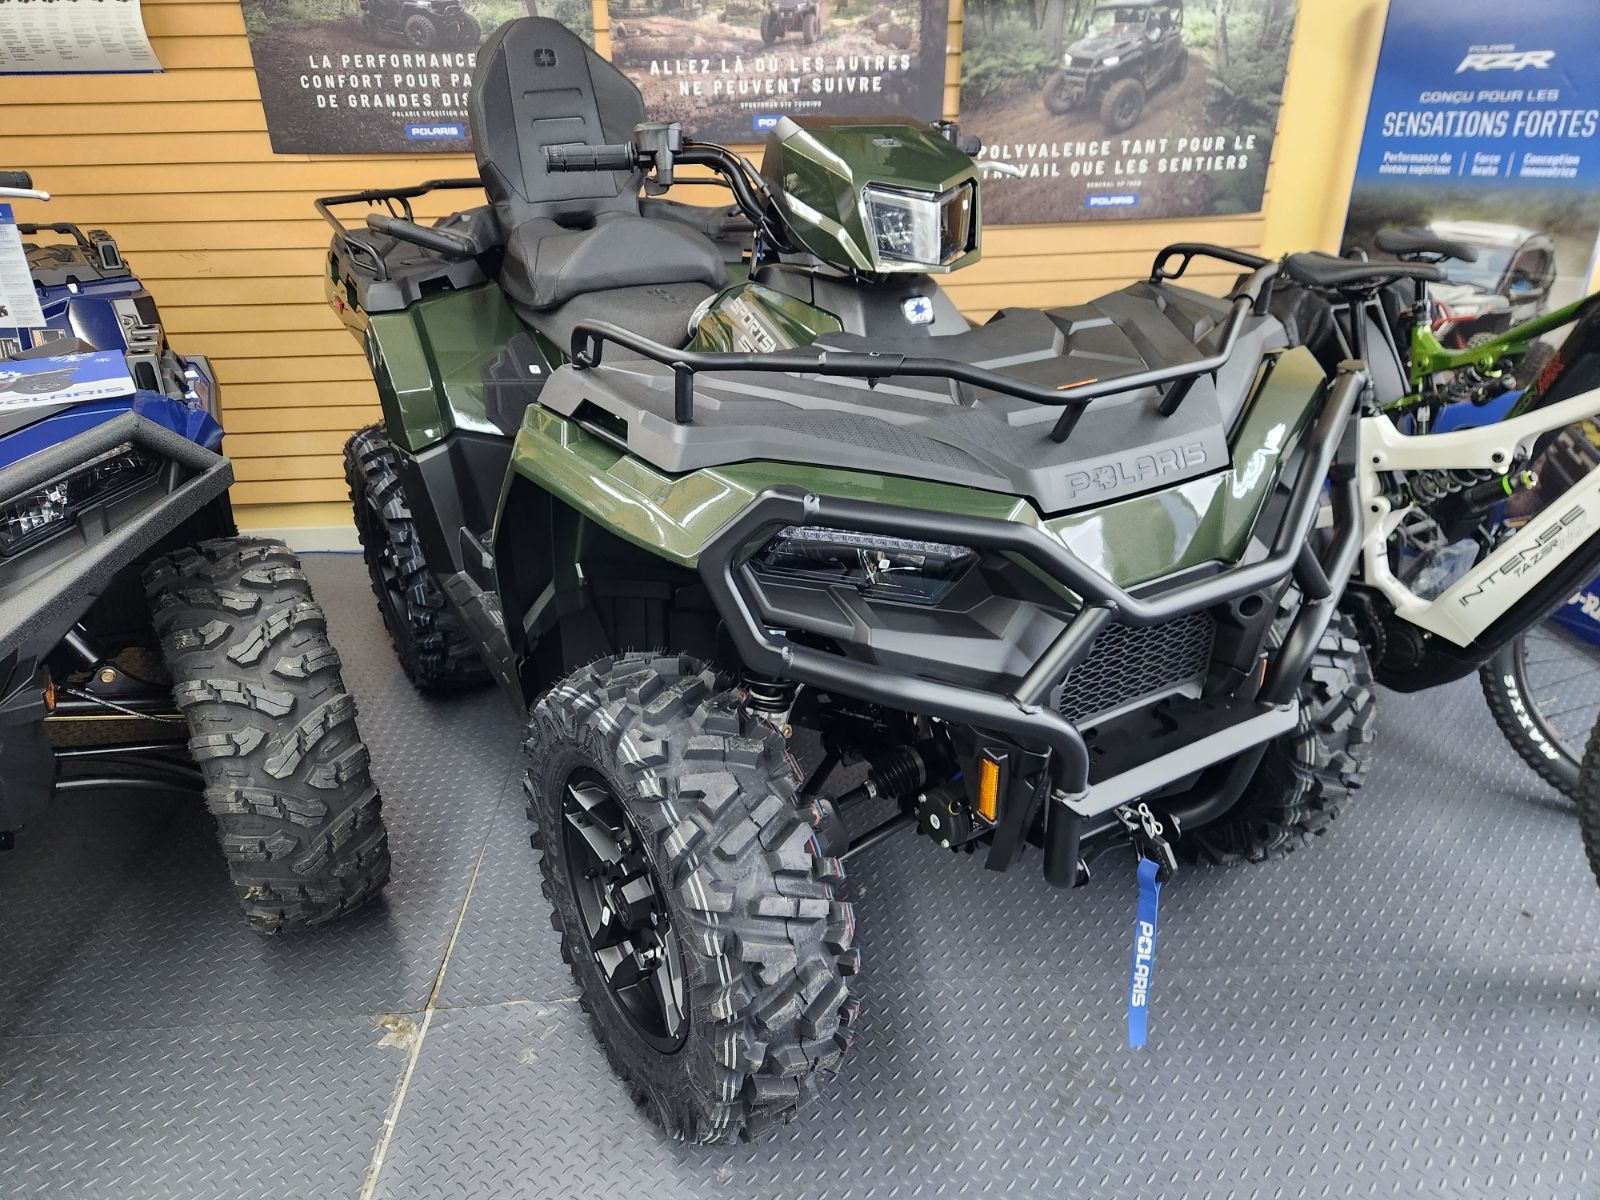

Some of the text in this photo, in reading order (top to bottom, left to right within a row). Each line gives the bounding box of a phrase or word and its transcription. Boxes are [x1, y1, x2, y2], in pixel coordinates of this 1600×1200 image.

[309, 53, 477, 69] LA PERFORMANCE
[650, 54, 910, 75] ALLEZ LÀ OÙ LES AUTRES
[1455, 50, 1556, 74] RZR
[300, 74, 383, 89] CONFORT
[393, 73, 441, 88] POUR
[680, 76, 882, 96] NE PEUVENT SUIVRE
[317, 94, 339, 108] DE
[348, 93, 432, 108] GRANDES
[1419, 88, 1560, 105] CONÇU POUR LES
[411, 126, 459, 136] POLARIS
[1382, 109, 1600, 138] SENSATIONS FORTES
[977, 134, 1257, 161] POLYVALENCE TANT POUR LE
[1070, 160, 1106, 178] QUE
[1114, 158, 1149, 175] LES
[1158, 154, 1249, 173] SENTIERS
[1090, 196, 1135, 206] POLARIS
[0, 386, 125, 405] OLARIS
[1064, 441, 1208, 498] POLARIS
[1459, 504, 1585, 607] INTENSE
[1131, 920, 1154, 1008] POLARIS
